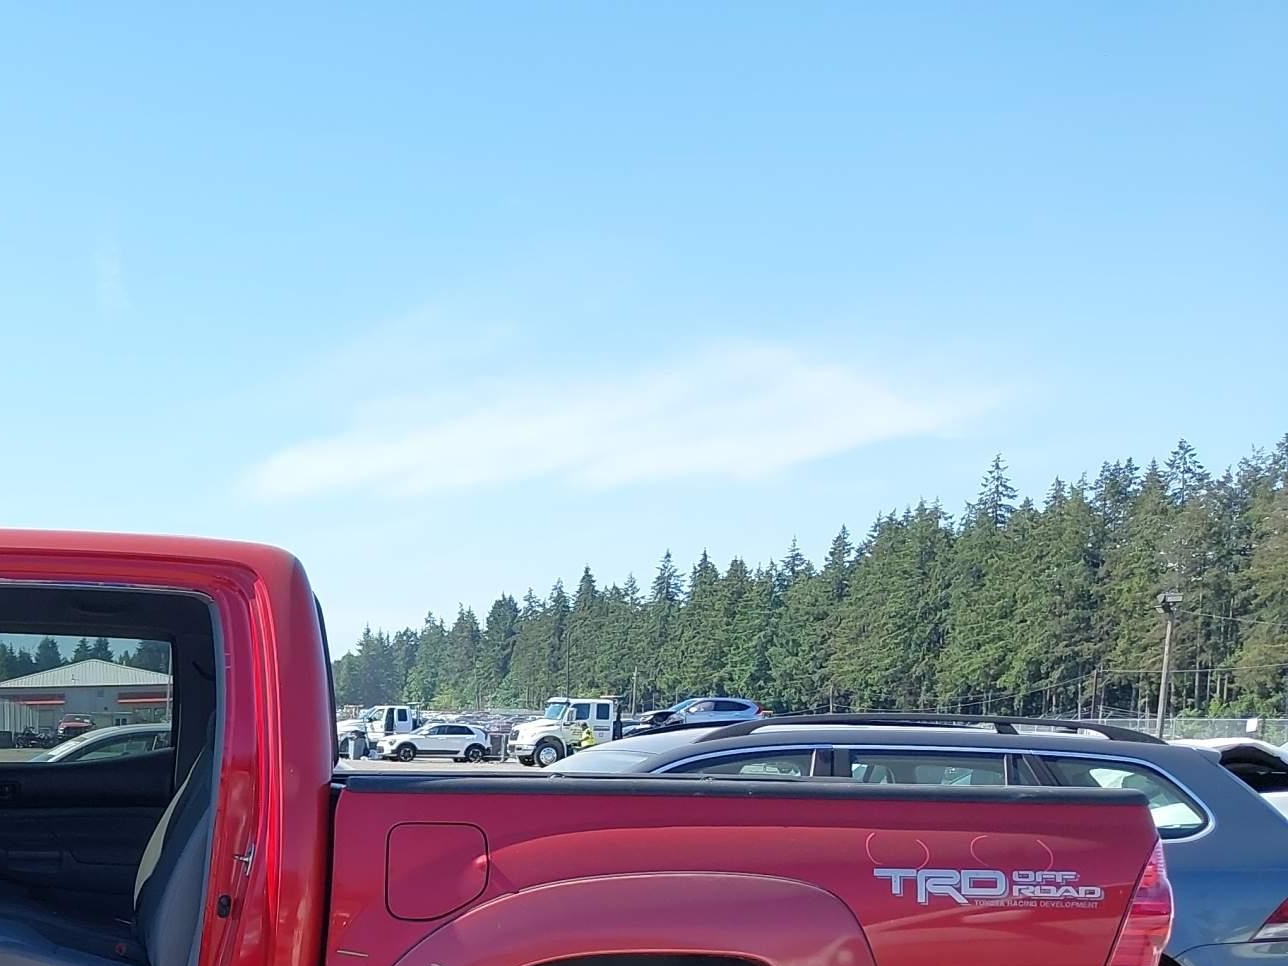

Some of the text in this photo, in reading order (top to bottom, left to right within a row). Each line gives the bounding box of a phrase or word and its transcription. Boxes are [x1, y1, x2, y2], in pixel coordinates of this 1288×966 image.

[1012, 870, 1080, 883] OFF
[873, 868, 1009, 905] TRD
[1012, 885, 1105, 900] ROAD
[1039, 900, 1099, 909] DEVELOPMENT
